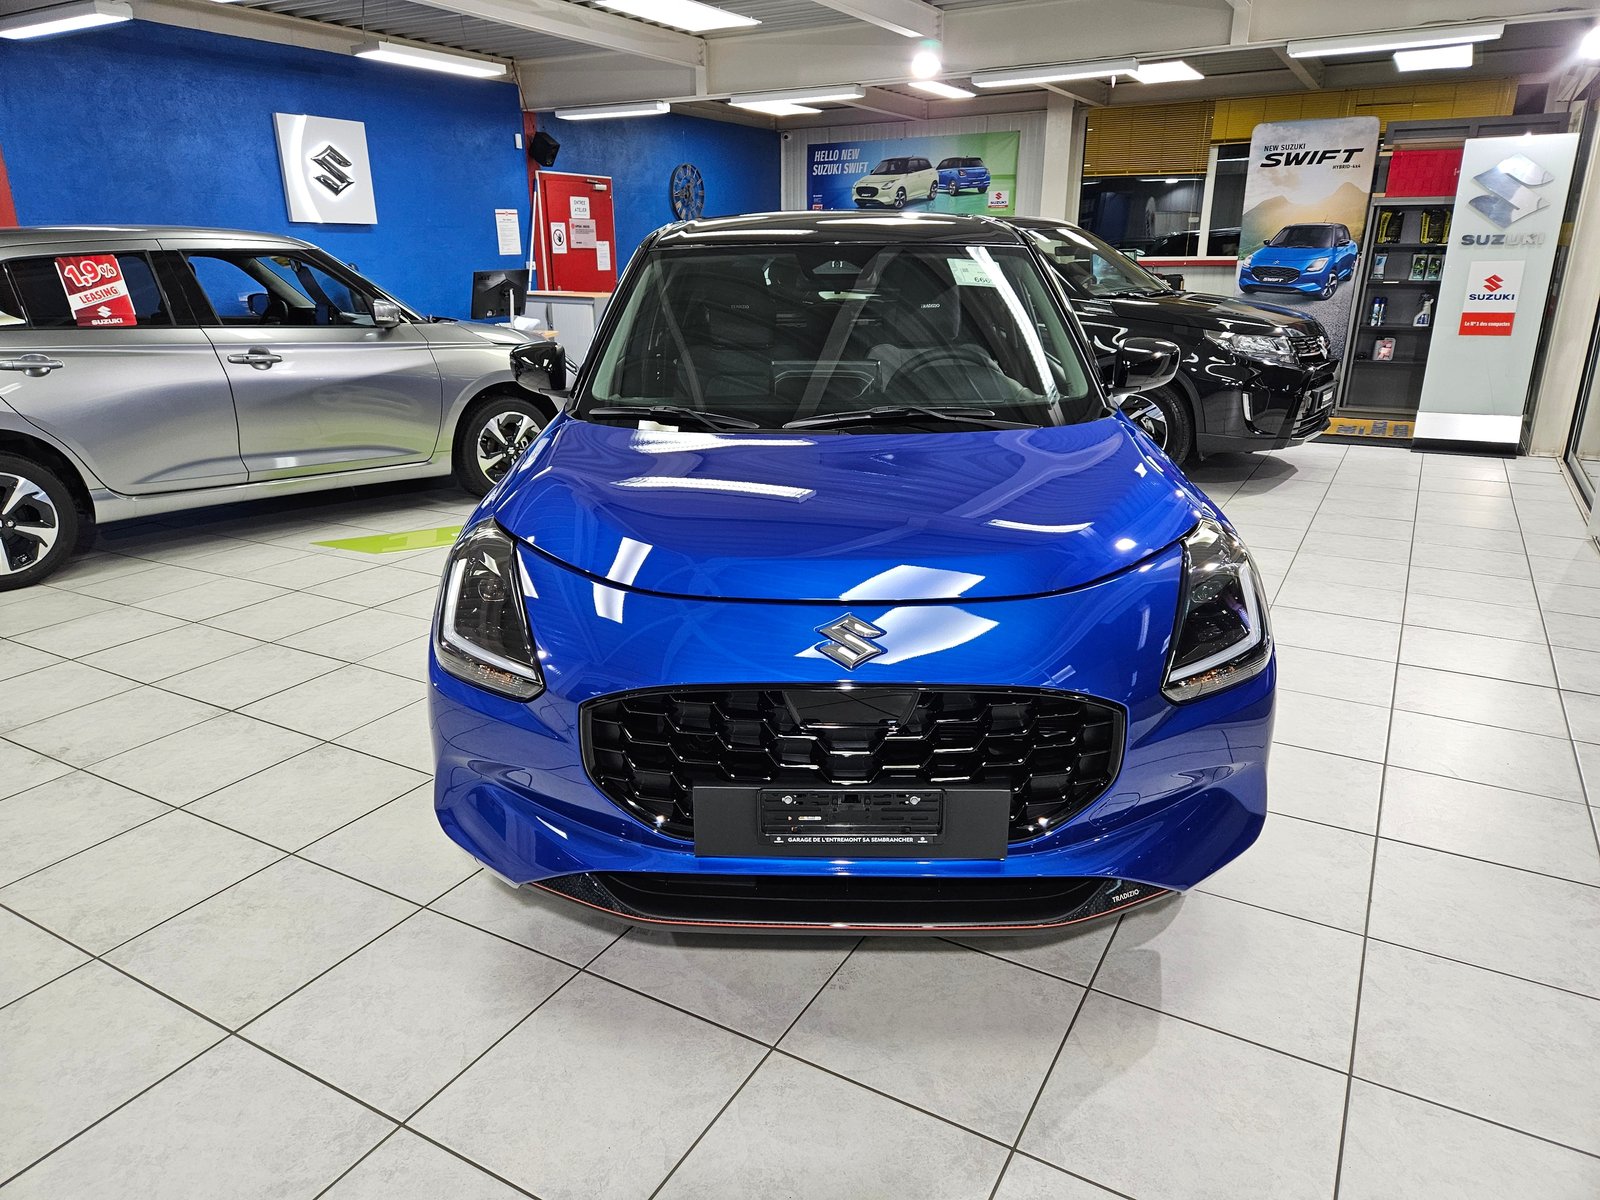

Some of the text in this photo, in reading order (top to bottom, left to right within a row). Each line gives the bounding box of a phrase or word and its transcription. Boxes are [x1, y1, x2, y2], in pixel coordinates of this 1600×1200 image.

[1280, 143, 1306, 151] SUZUKI
[814, 149, 860, 162] HELLO NEW
[1260, 148, 1365, 168] SWIFT
[812, 161, 869, 176] SUZUKI SWIFT
[1461, 233, 1545, 246] SUZUKI
[79, 286, 118, 304] LEASING
[1469, 293, 1515, 301] SUZUKI
[91, 318, 124, 326] SUZUKI
[787, 836, 812, 844] GARAGE
[812, 836, 821, 844] DE
[821, 836, 862, 844] L'ENTREMONT
[862, 836, 871, 844] SA
[871, 836, 914, 844] SEMBRANCHER
[1112, 889, 1139, 903] TRADIZIO
